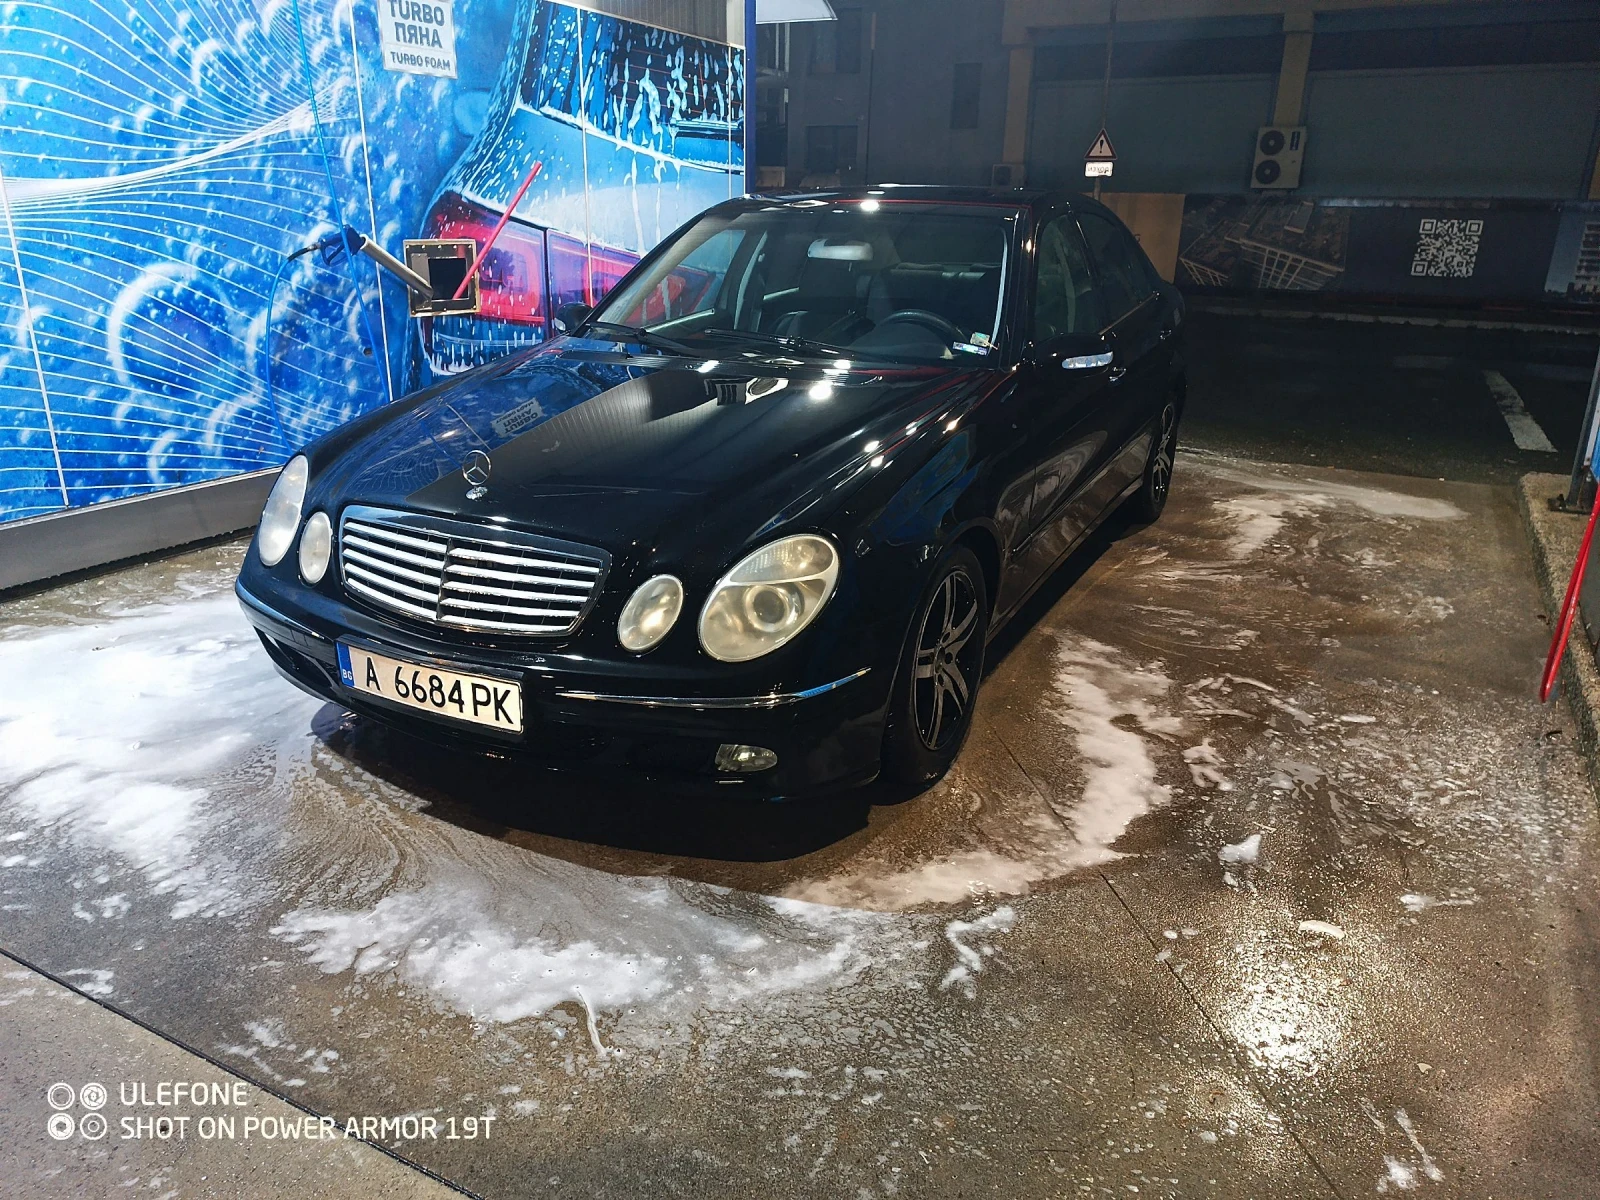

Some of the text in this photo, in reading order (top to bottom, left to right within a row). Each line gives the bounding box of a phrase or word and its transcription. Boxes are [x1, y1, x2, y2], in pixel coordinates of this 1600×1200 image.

[387, 0, 445, 27] TURBO
[394, 21, 443, 49] ПЯНА
[390, 51, 451, 71] TURBO FOAM
[342, 668, 353, 681] BG
[365, 656, 382, 692] A
[394, 666, 465, 714] 6684
